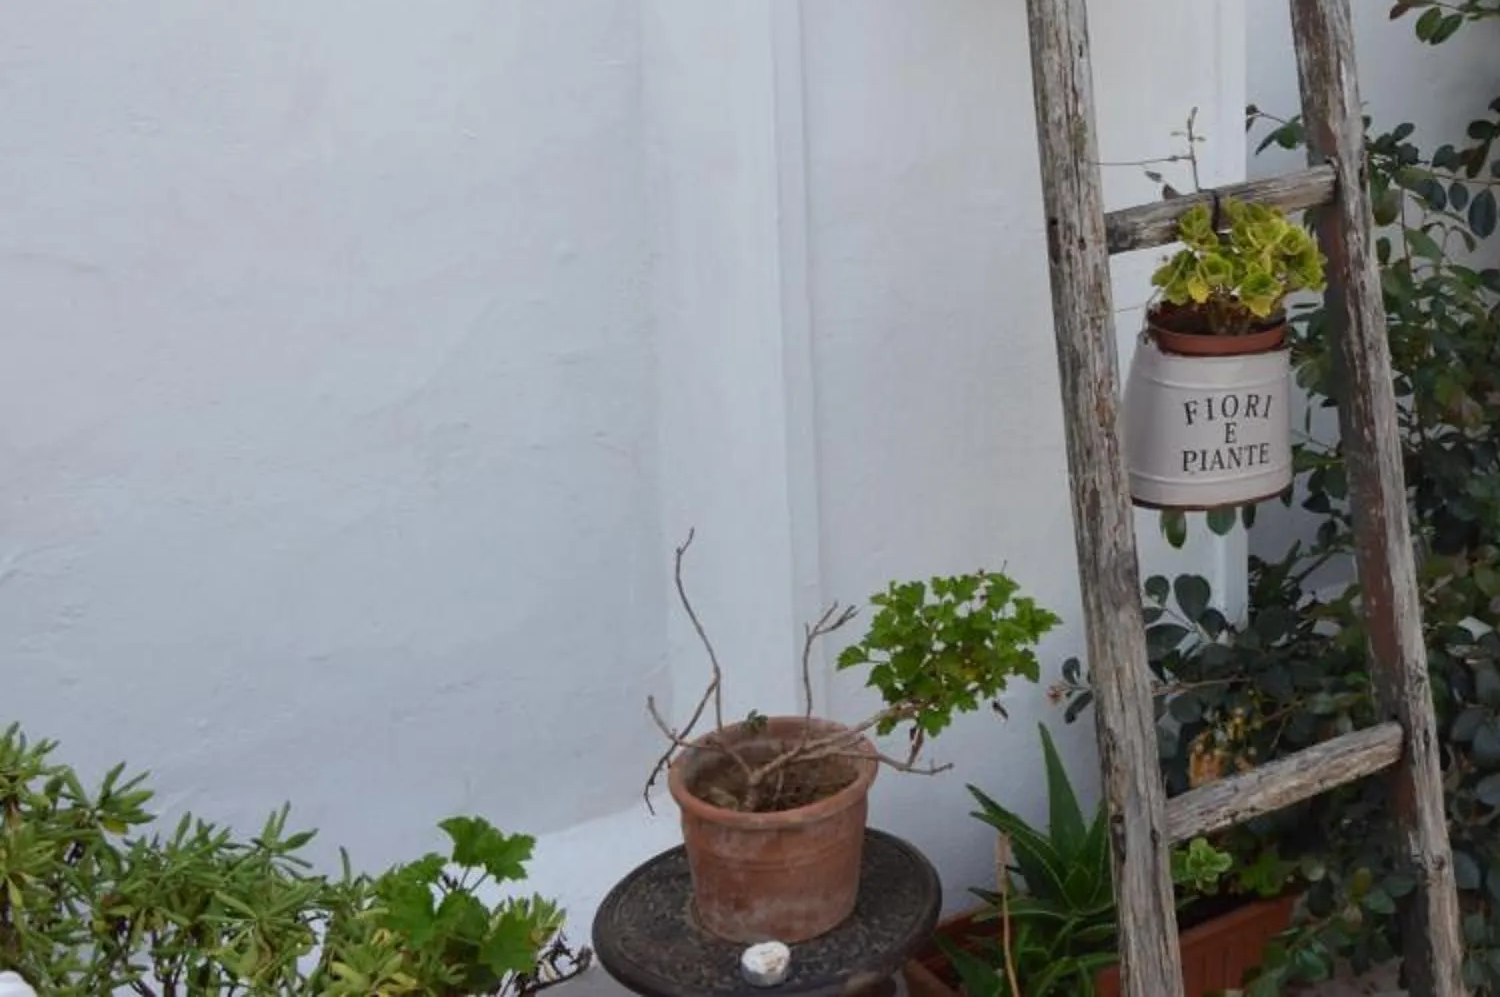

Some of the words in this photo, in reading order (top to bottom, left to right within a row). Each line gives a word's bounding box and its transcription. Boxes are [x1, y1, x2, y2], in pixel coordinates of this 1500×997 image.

[1183, 394, 1273, 425] FIORI
[1224, 421, 1237, 444] E
[1181, 442, 1270, 472] PIANTE
